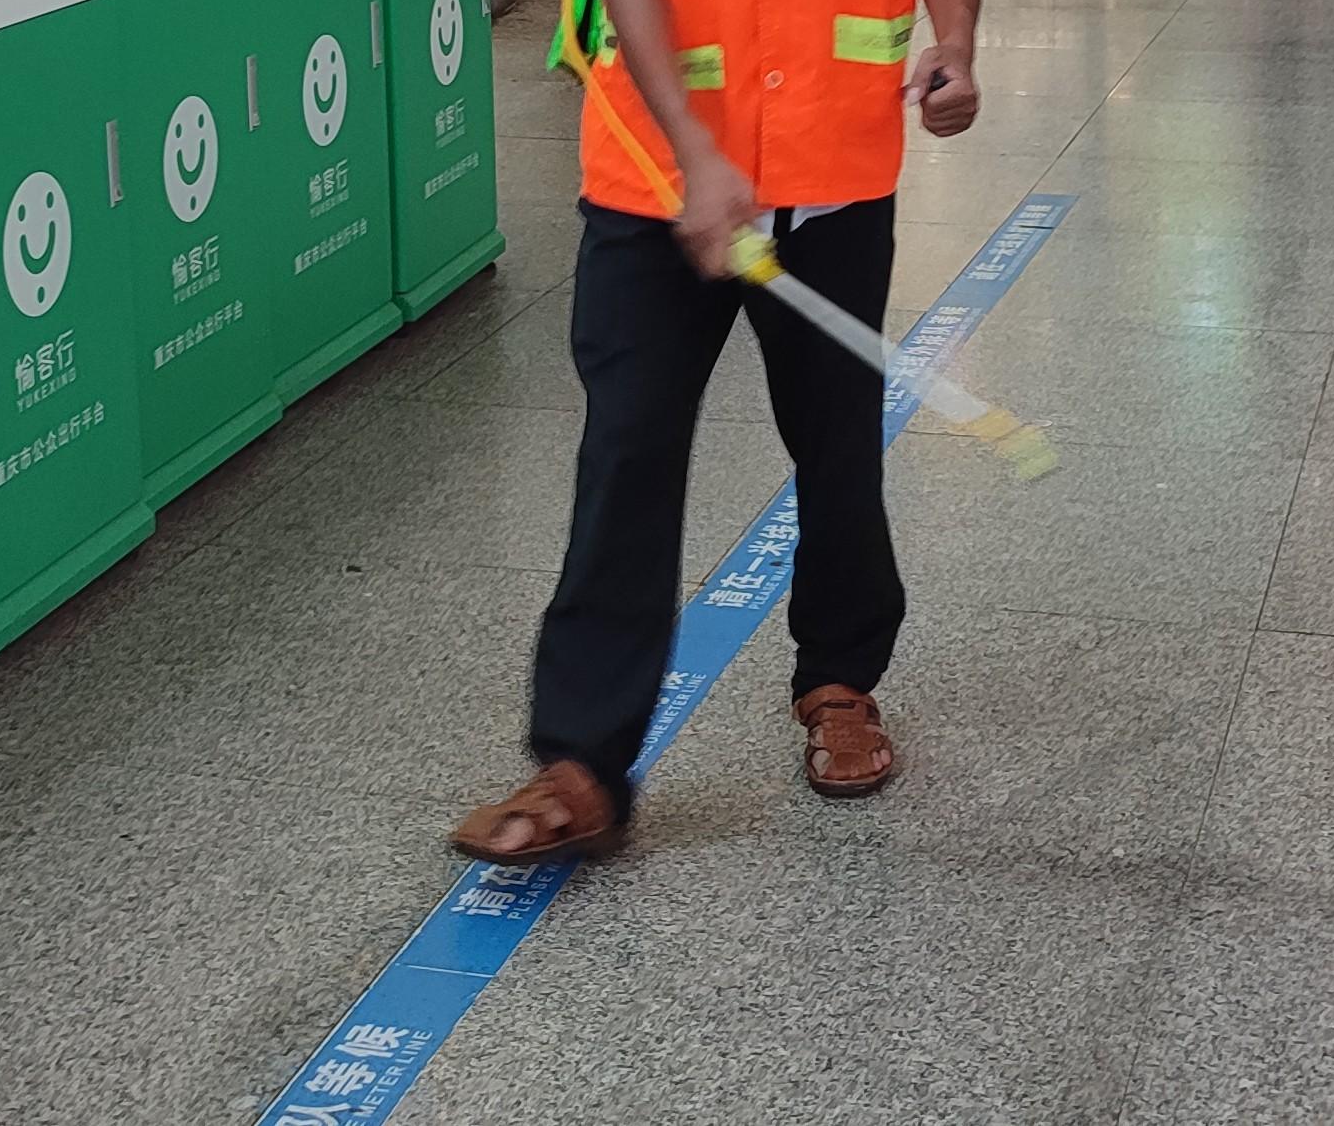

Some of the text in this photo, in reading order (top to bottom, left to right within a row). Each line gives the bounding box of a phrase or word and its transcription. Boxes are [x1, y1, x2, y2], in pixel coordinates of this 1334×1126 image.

[15, 328, 75, 395] 愉客行
[17, 366, 77, 414] YUKEXING
[450, 863, 540, 917] 请在
[507, 875, 554, 920] PLEASE
[353, 1030, 433, 1118] METER LINE
